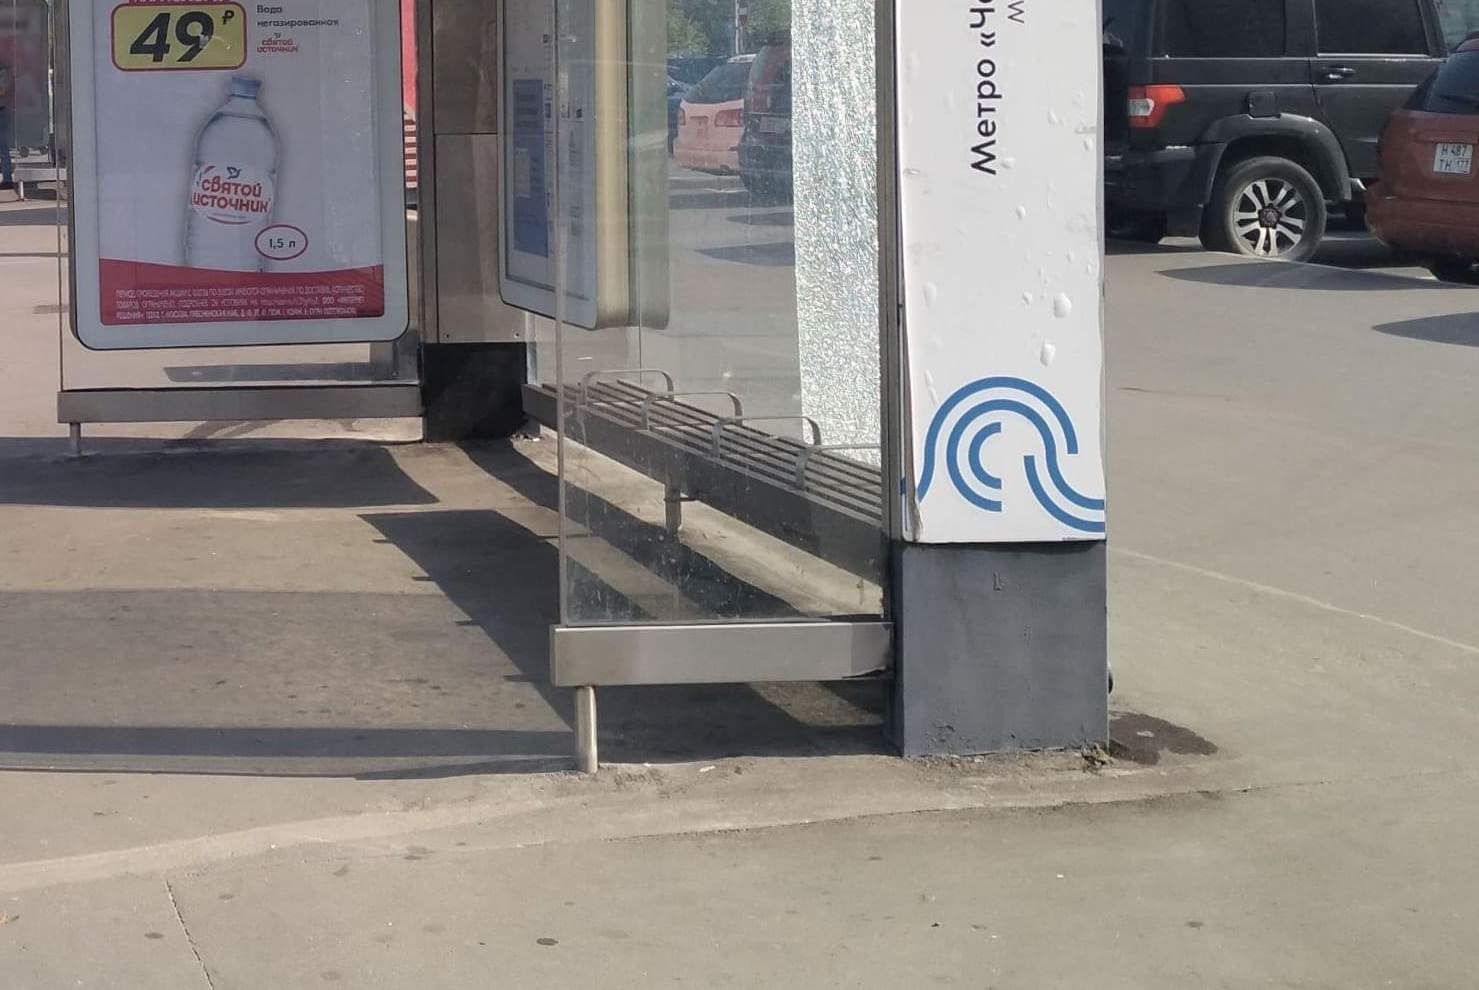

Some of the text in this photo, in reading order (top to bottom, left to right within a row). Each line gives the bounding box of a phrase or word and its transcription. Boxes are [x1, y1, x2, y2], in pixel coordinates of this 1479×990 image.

[256, 4, 283, 14] Вода
[257, 19, 339, 29] негазированная
[970, 59, 1003, 176] Метро
[269, 238, 284, 250] 1,5
